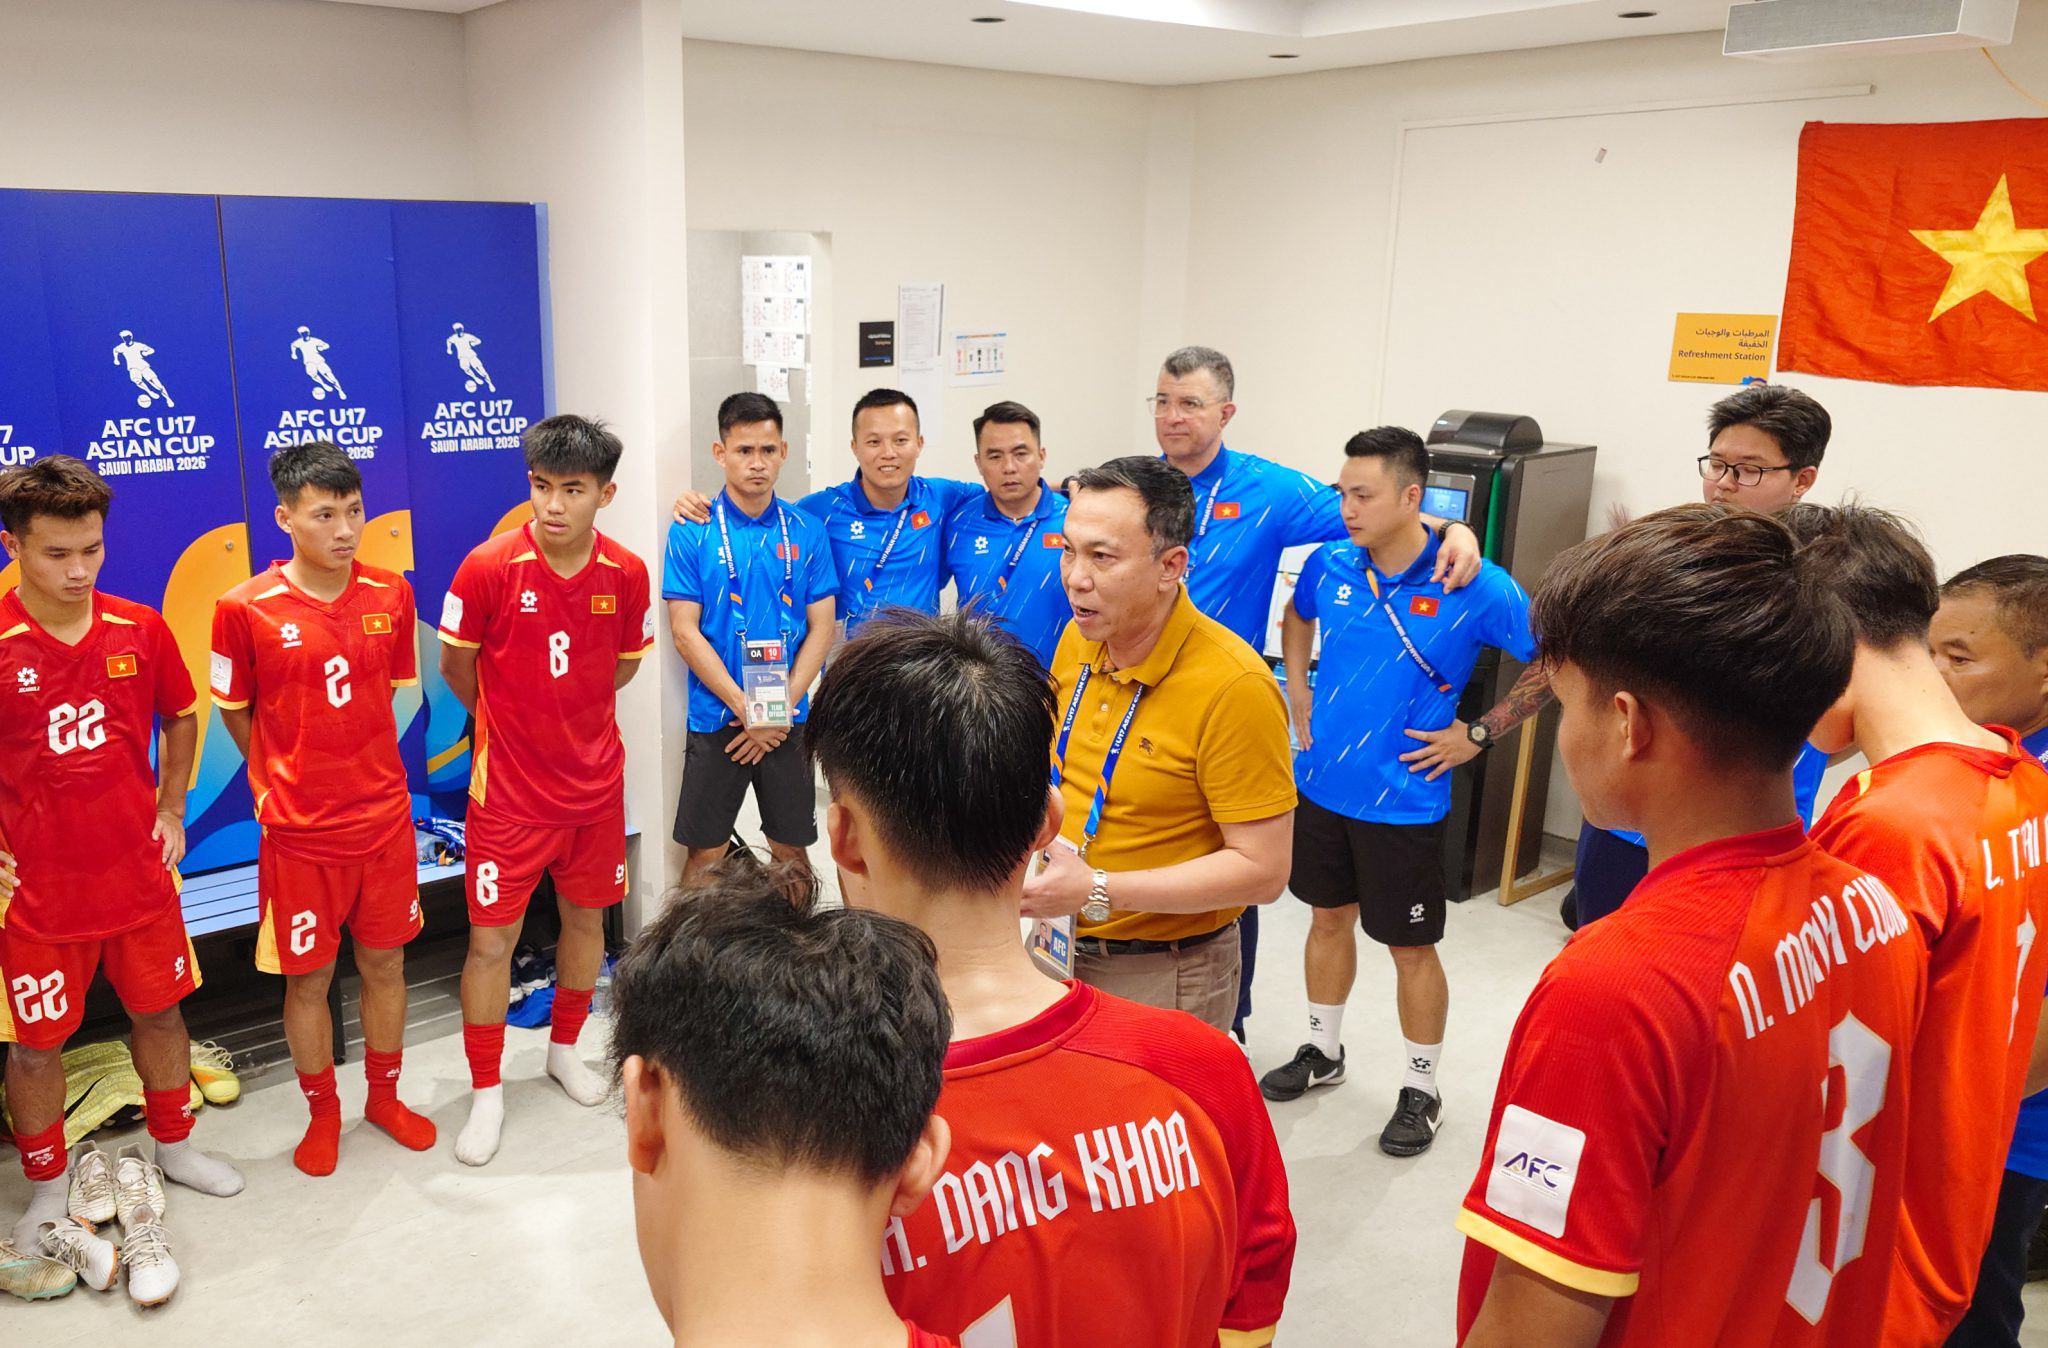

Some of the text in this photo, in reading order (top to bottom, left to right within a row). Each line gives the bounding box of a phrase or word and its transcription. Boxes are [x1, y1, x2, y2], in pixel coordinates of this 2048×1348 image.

[1678, 350, 1766, 361] Refreshment Station
[101, 415, 196, 439] AFC U17
[278, 407, 366, 429] AFC U17
[434, 399, 513, 420] AFC U17
[263, 426, 383, 449] ASIAN CUP
[421, 417, 528, 440] ASIAN CUP
[430, 435, 521, 453] SAUDI ARABIA 2026
[85, 435, 215, 460] ASIAN CUP
[98, 455, 207, 476] SAUDI ARABIA 2026
[347, 446, 375, 459] 2026
[549, 630, 571, 679] 8
[750, 648, 778, 658] OA 10
[324, 654, 352, 709] 2
[1066, 707, 1075, 720] U17
[1072, 682, 1084, 707] ASIAN
[48, 698, 107, 755] 22
[1115, 728, 1125, 744] U17
[1123, 704, 1135, 730] ASIAN
[1982, 838, 2004, 890] L.
[476, 861, 499, 907] 8
[290, 909, 317, 956] 2
[1052, 936, 1067, 958] AFC
[12, 969, 69, 1024] 22
[1729, 961, 1775, 1040] N.
[932, 1142, 1069, 1255] DANG
[1073, 1110, 1201, 1213] KHOA
[1503, 1151, 1563, 1188] AFC
[1785, 1010, 1892, 1326] 3
